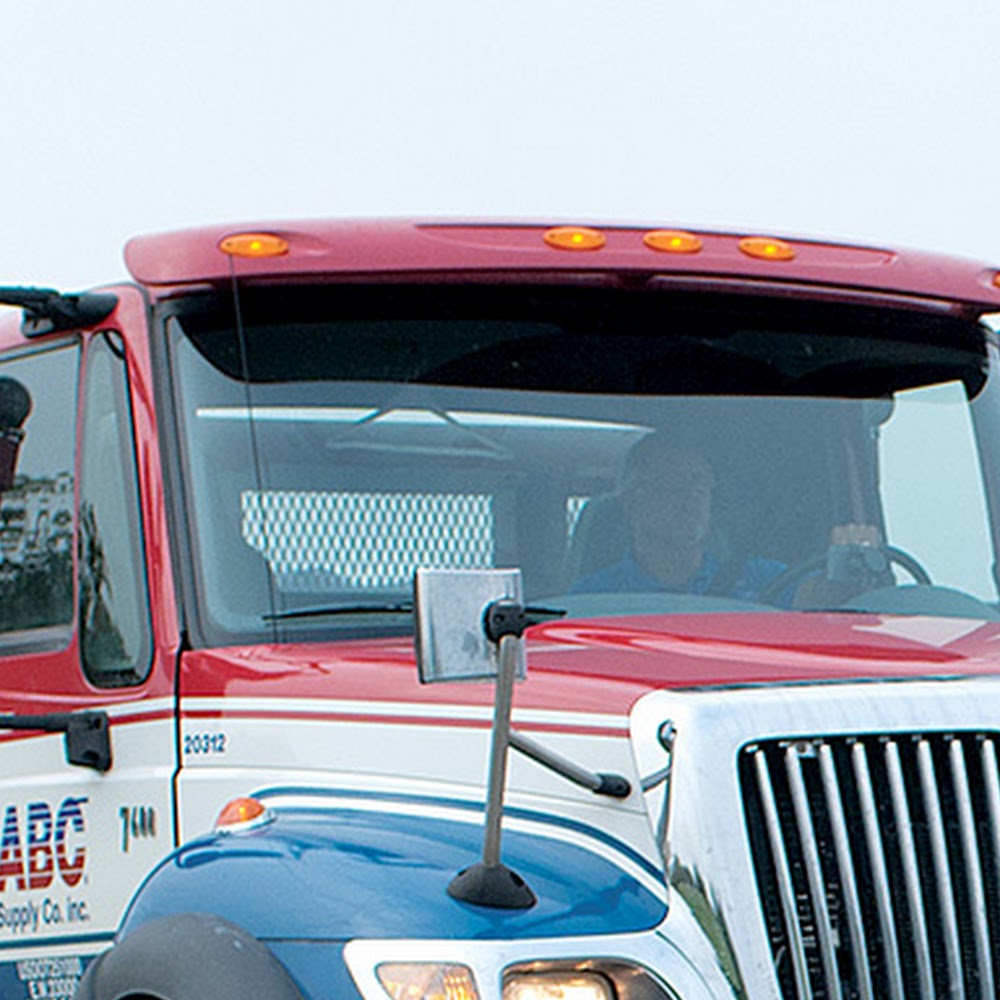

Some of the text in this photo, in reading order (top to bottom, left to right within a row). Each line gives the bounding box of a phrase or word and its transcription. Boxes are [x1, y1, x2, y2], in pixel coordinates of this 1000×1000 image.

[184, 733, 226, 754] 20312
[0, 797, 88, 891] ABC
[42, 898, 63, 924] Co.
